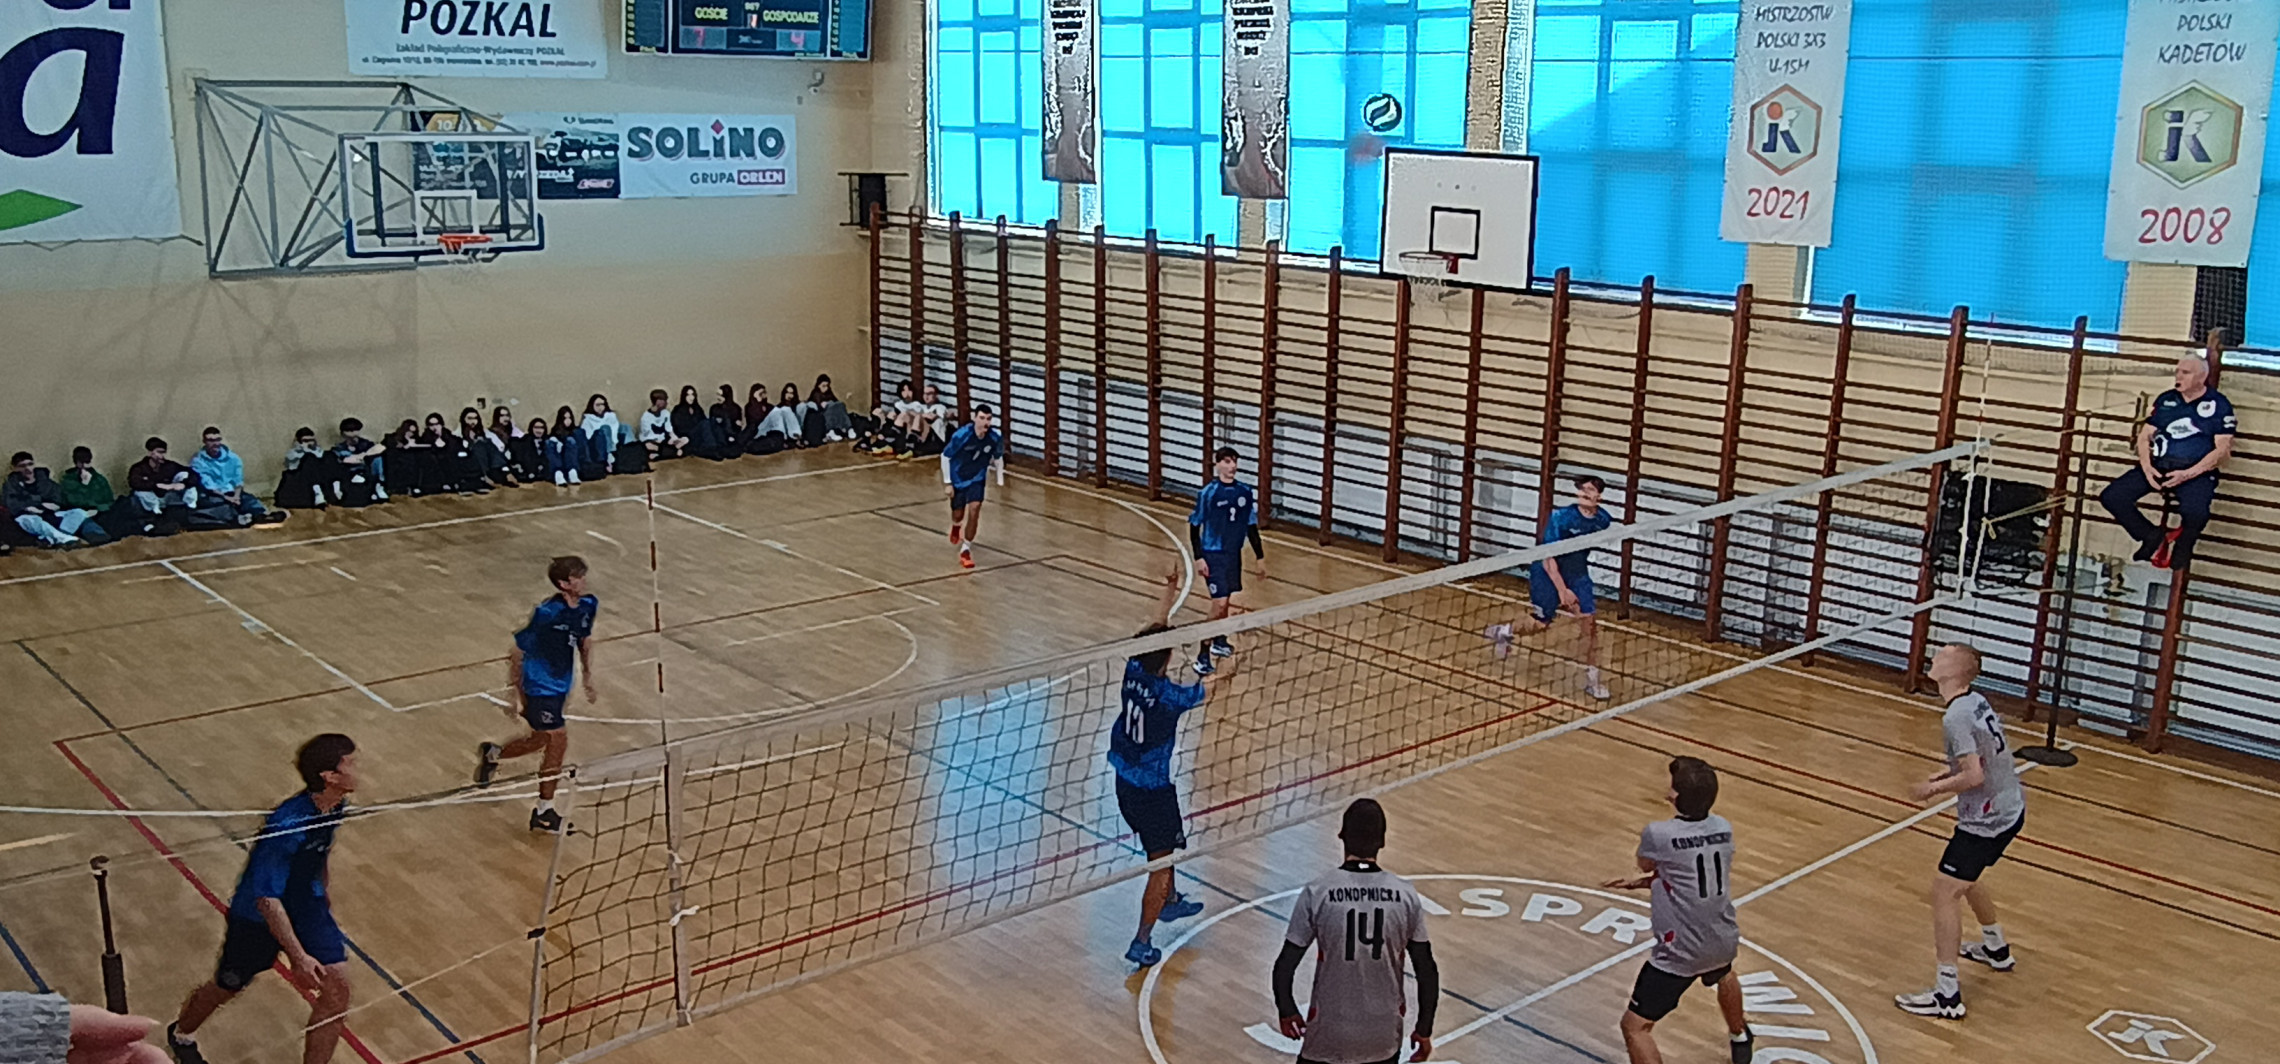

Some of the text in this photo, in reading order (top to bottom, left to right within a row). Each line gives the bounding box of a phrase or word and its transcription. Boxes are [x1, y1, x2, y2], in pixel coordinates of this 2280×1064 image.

[400, 0, 557, 38] POZKAL
[2177, 13, 2232, 31] POLSKI
[1756, 31, 1800, 49] POLSKI
[690, 171, 784, 186] GRUPA ORLEN
[1746, 186, 1810, 220] 2021
[2138, 206, 2231, 245] 2008
[1985, 714, 2005, 755] 5
[1696, 851, 1723, 898] 11
[1328, 887, 1402, 903] KONOPNICKA
[1344, 907, 1385, 961] 14
